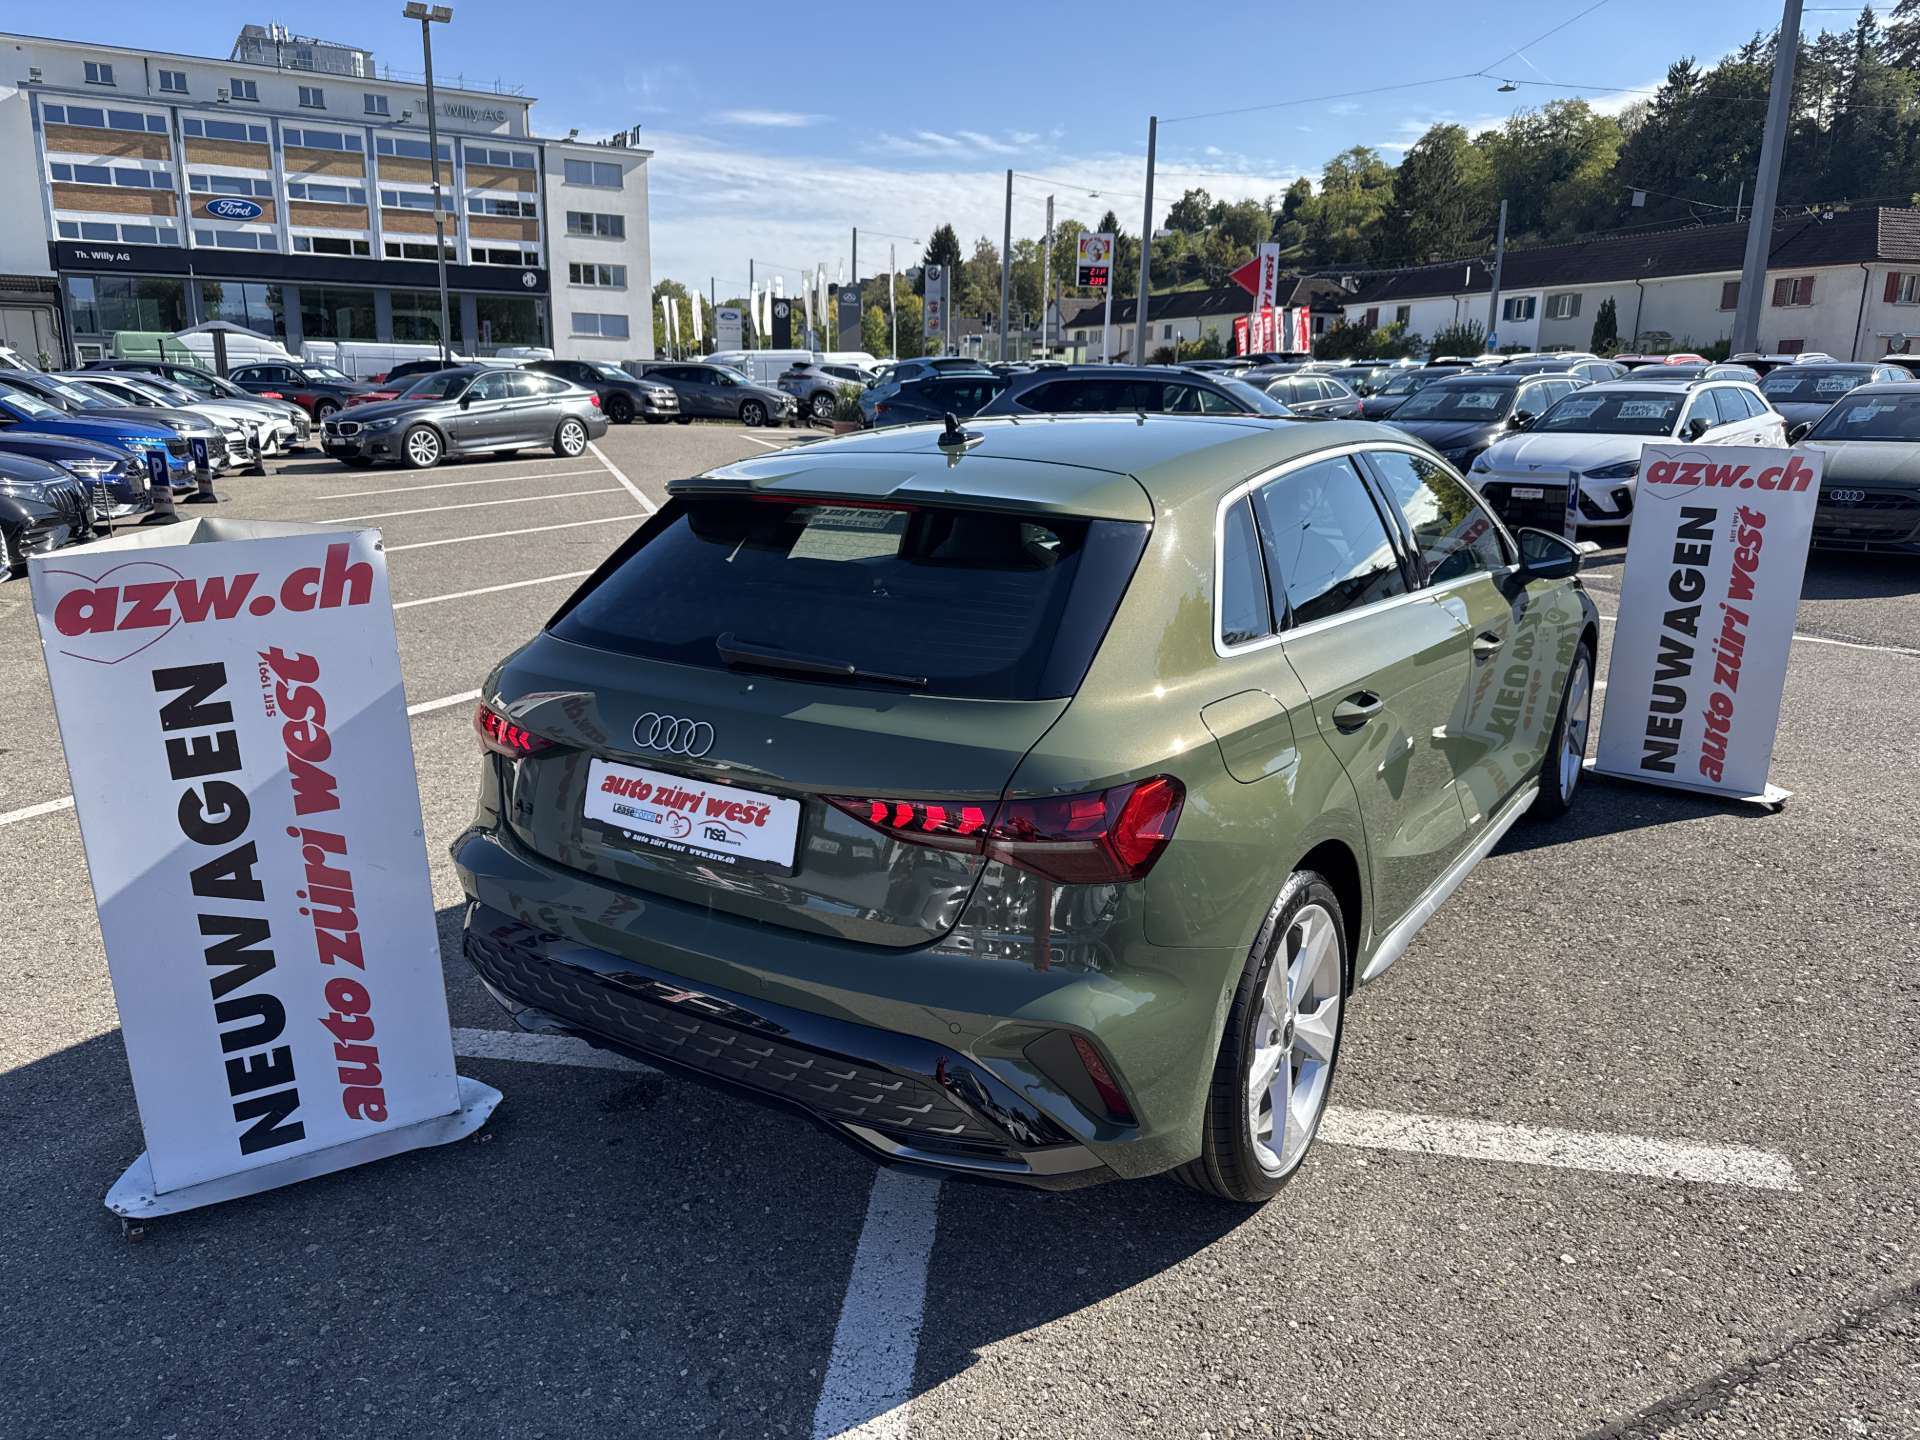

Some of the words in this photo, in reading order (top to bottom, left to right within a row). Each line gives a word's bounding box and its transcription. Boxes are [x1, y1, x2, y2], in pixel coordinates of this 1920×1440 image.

[445, 103, 479, 123] Willy
[483, 107, 506, 122] AG
[217, 201, 252, 217] Ford
[75, 250, 89, 260] Th.
[91, 250, 114, 262] Willy
[116, 252, 131, 262] AG
[1264, 254, 1275, 290] west
[152, 457, 163, 481] P
[1646, 456, 1814, 493] azw.ch
[1570, 477, 1577, 504] P
[1727, 504, 1767, 601] west
[54, 543, 374, 637] azw.ch
[1640, 506, 1718, 774] NEUWAGEN
[1711, 602, 1749, 694] züri
[258, 660, 272, 688] 1991
[263, 689, 278, 718] SEIT
[258, 645, 341, 817] west
[1699, 692, 1734, 783] auto
[515, 799, 534, 816] A3
[601, 774, 653, 801] auto
[651, 785, 706, 814] züri
[705, 797, 771, 828] west
[633, 832, 650, 844] auto
[650, 837, 667, 849] züri
[667, 842, 686, 853] west
[689, 848, 736, 865] www.azw.ch
[704, 826, 726, 843] nsa
[152, 661, 306, 1156] NEUWAGEN
[286, 824, 366, 972] züri
[317, 982, 388, 1124] auto
